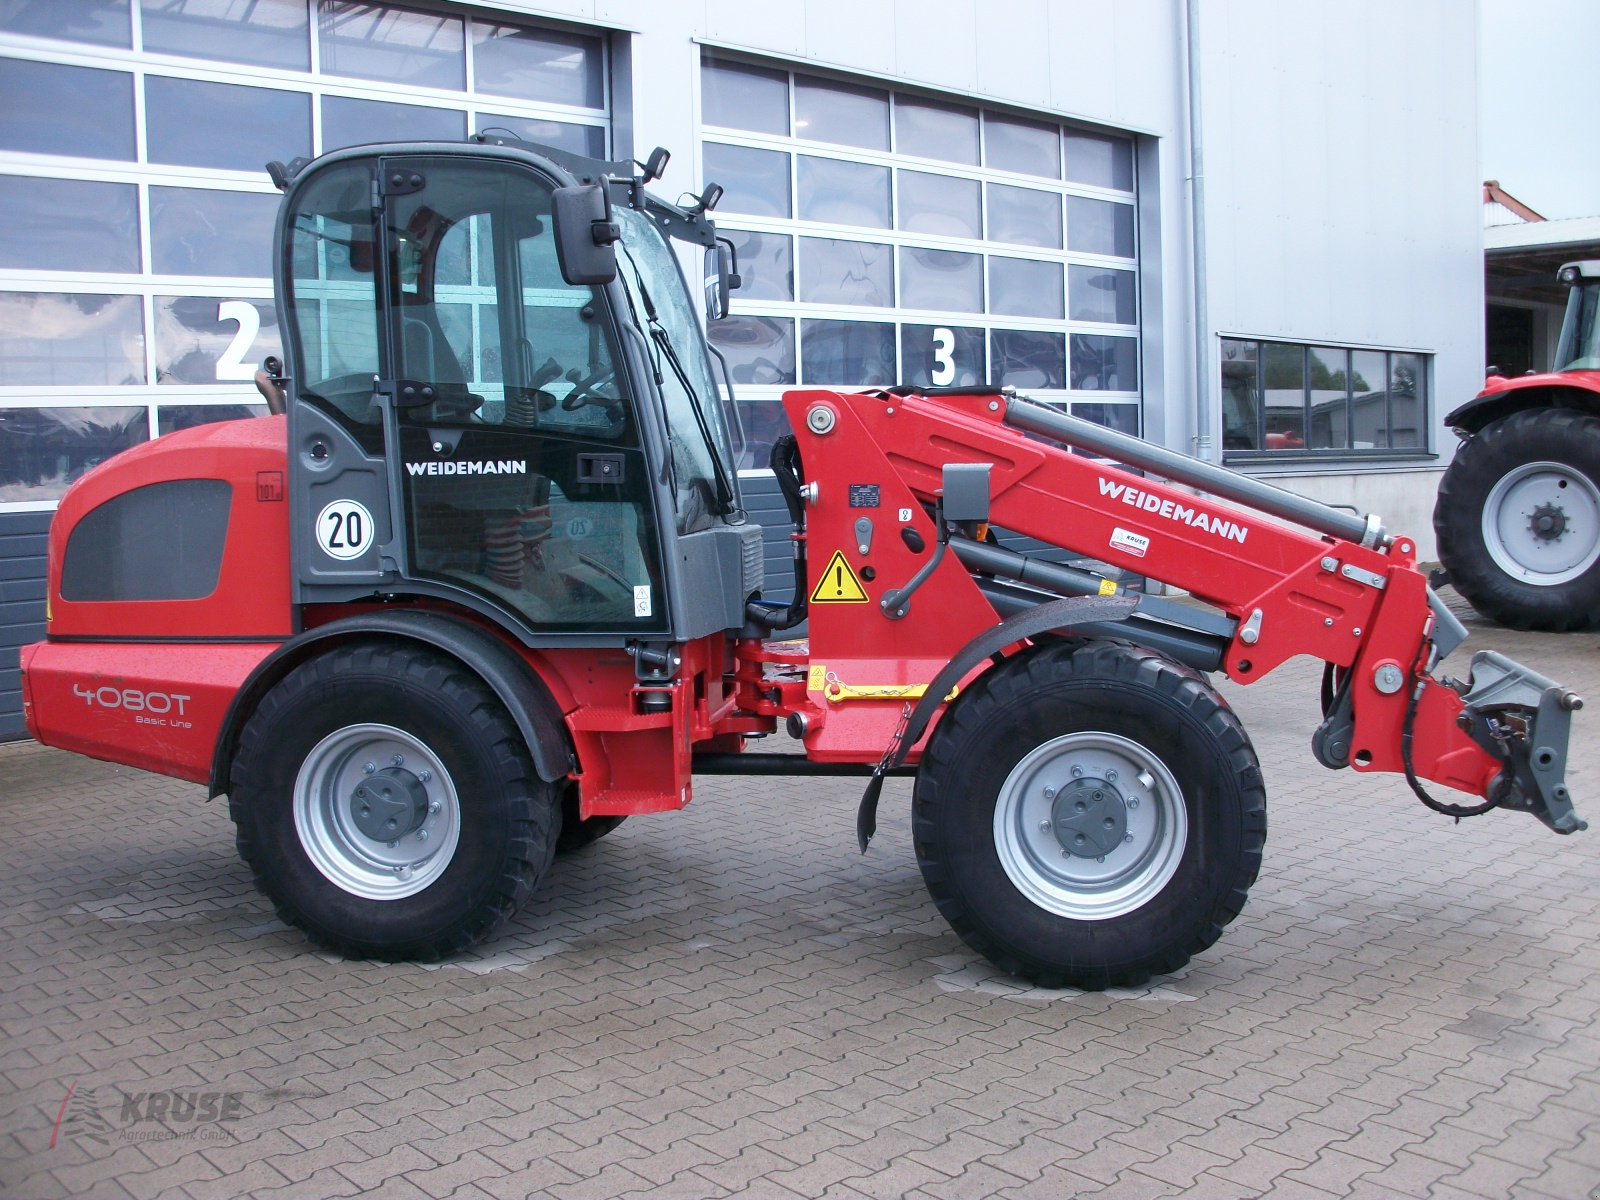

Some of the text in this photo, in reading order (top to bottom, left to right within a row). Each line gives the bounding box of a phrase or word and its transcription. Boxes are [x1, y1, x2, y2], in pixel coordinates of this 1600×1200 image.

[215, 301, 261, 381] 2
[931, 328, 956, 386] 3
[405, 460, 527, 476] WEIDEMANN
[1097, 477, 1248, 545] WEIDEMANN
[328, 511, 363, 548] 20
[1126, 535, 1147, 546] KRUSE
[73, 684, 191, 715] 4080T
[135, 716, 192, 728] Basic Line
